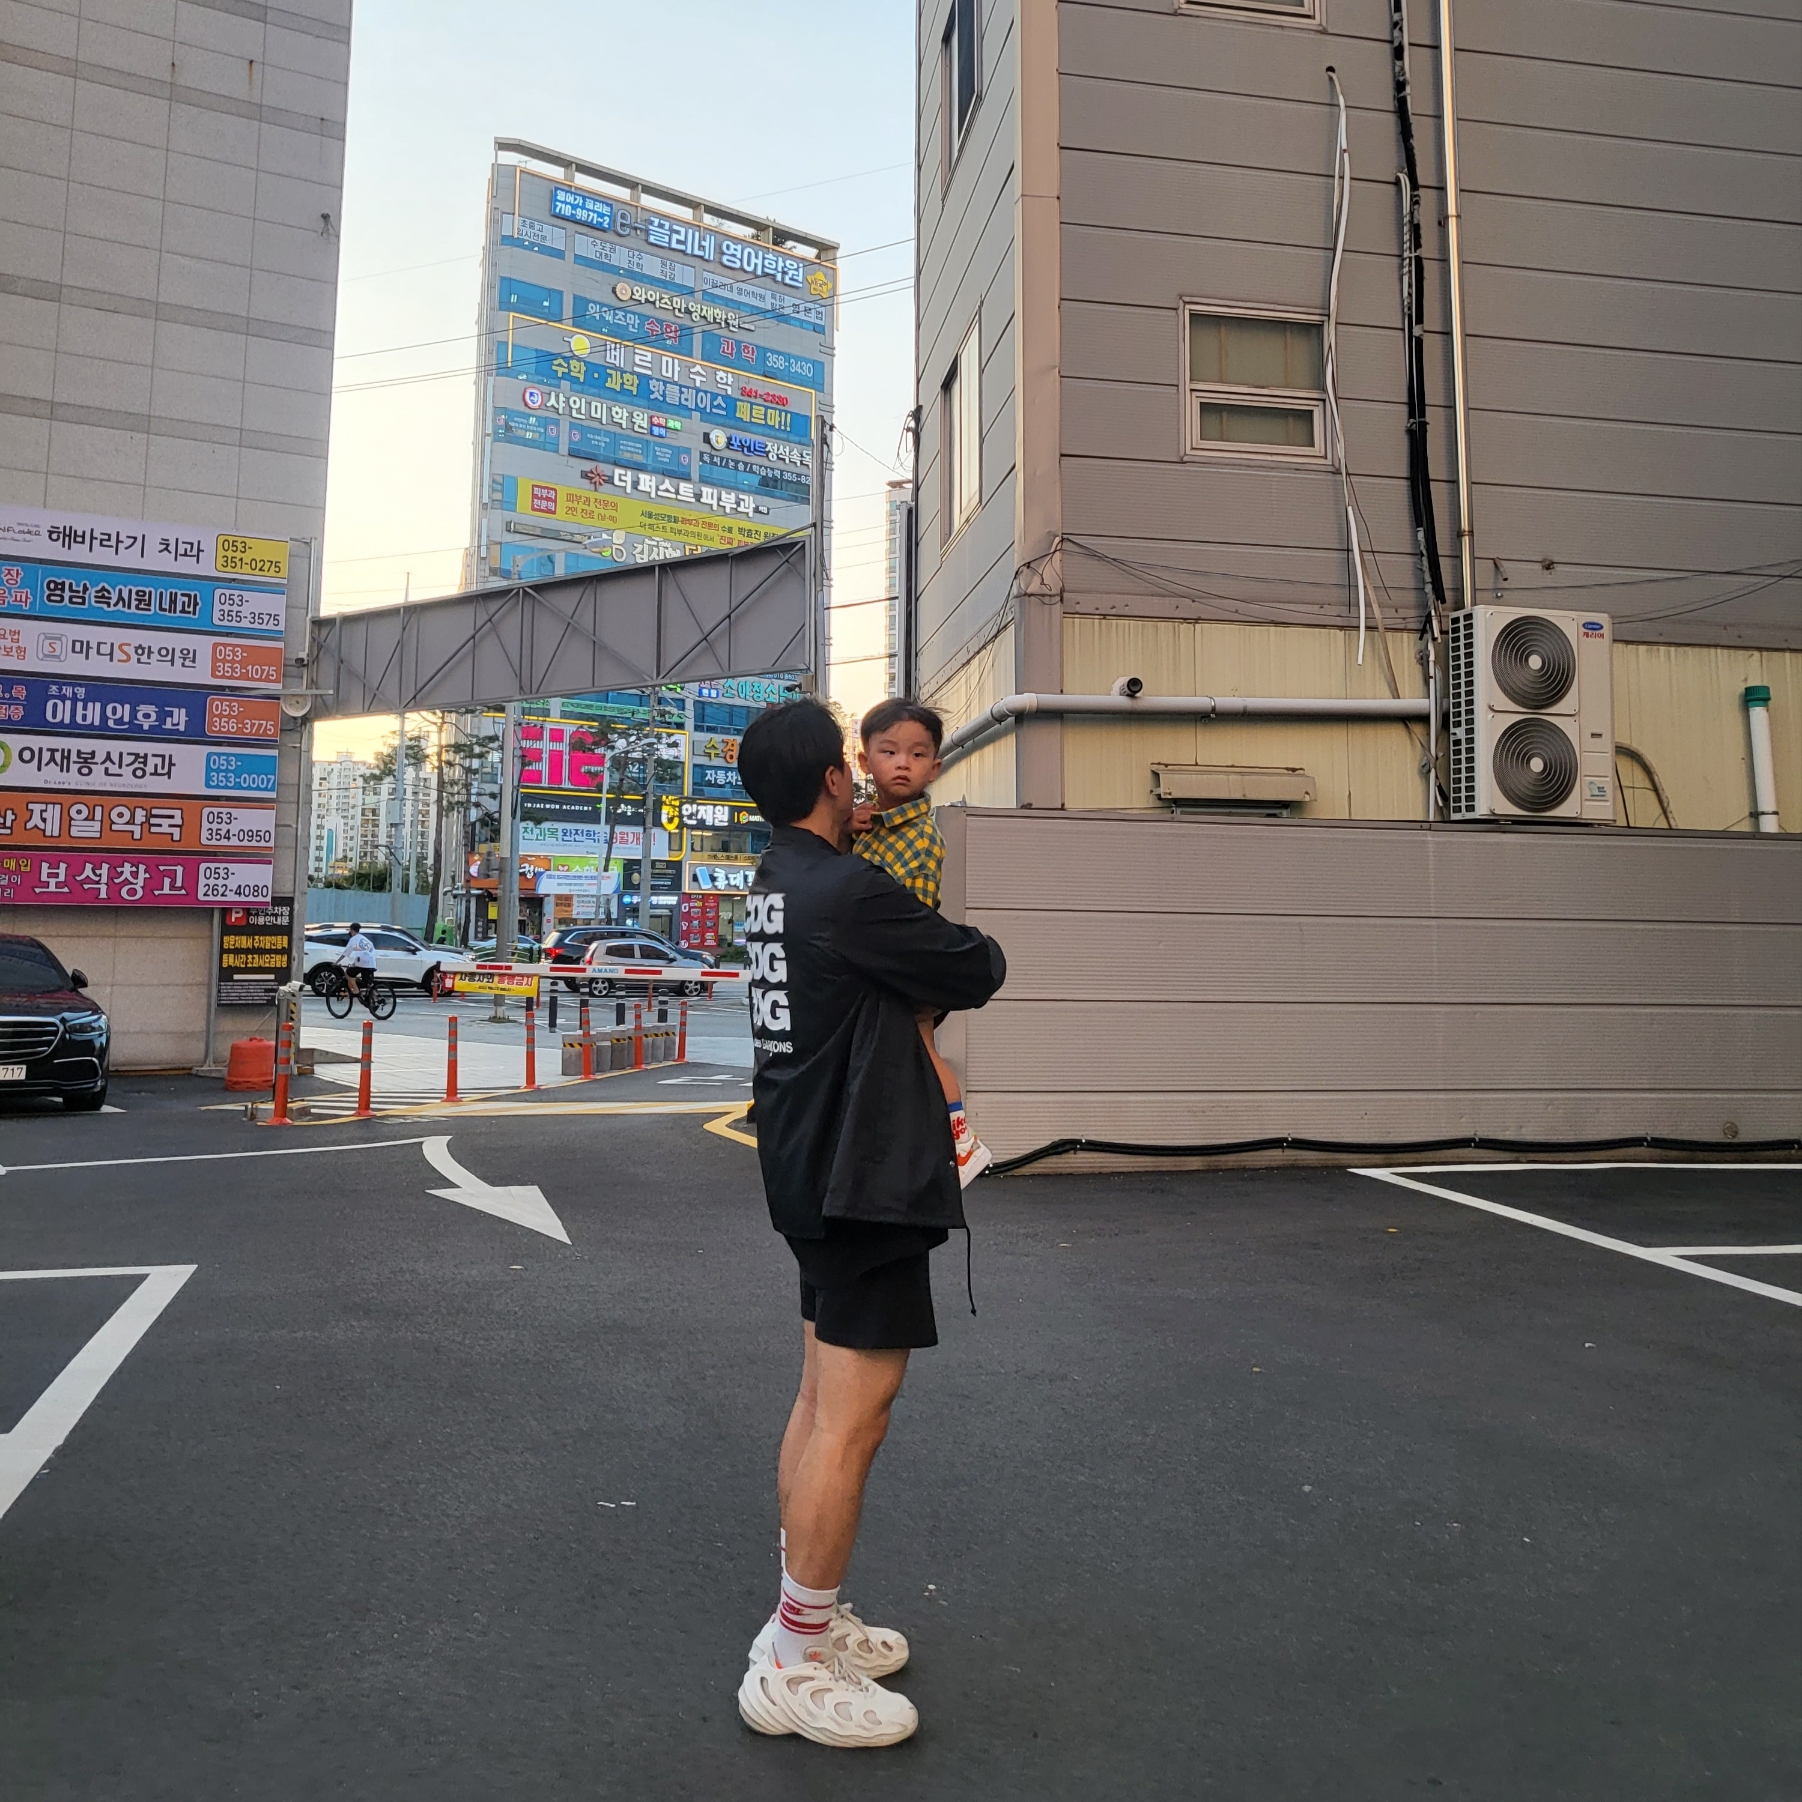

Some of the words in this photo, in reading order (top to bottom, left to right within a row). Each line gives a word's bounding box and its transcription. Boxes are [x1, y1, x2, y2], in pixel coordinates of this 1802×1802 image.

[721, 240, 804, 288] 영어학원
[632, 286, 687, 318] 와이즈만
[688, 301, 739, 332] 영재학원
[586, 302, 640, 332] 와이즈만
[766, 352, 814, 377] 358-3430
[649, 378, 727, 416] 핫플레이스
[545, 391, 648, 434] 샤인미학원
[565, 493, 592, 507] 피부과
[593, 497, 619, 512] 전문의
[613, 468, 632, 494] 더
[637, 473, 696, 503] 퍼스트
[699, 485, 756, 518] 피부과
[47, 524, 147, 558] 해바라기
[158, 536, 205, 564] 치과
[222, 538, 254, 554] 053-
[221, 555, 282, 574] 351-0275
[45, 578, 90, 607] 영남
[93, 583, 153, 612] 속시원
[158, 590, 200, 617] 내과
[219, 592, 250, 606] 053-
[217, 608, 281, 627] 355-3575
[0, 644, 27, 661] 보험
[216, 646, 247, 661] 053-
[215, 662, 278, 681] 353-1075
[47, 684, 86, 699] 조재영
[45, 699, 190, 732] 이비인후과
[212, 701, 245, 716] 053-
[211, 717, 276, 735] 356-3775
[18, 746, 177, 780] 이재봉신경과
[210, 755, 242, 771] 053-
[209, 772, 276, 790] 353-0007
[25, 802, 184, 842] 제일약국
[206, 811, 239, 826] 053-
[681, 804, 729, 827] 인재원
[205, 827, 272, 844] 354-0950
[521, 826, 559, 843] 전과목
[0, 858, 31, 872] 매입
[203, 866, 236, 881] 053-
[33, 860, 188, 901] 보석창고
[202, 883, 270, 899] 262-4080
[746, 942, 788, 984] DG
[751, 986, 791, 1031] DG
